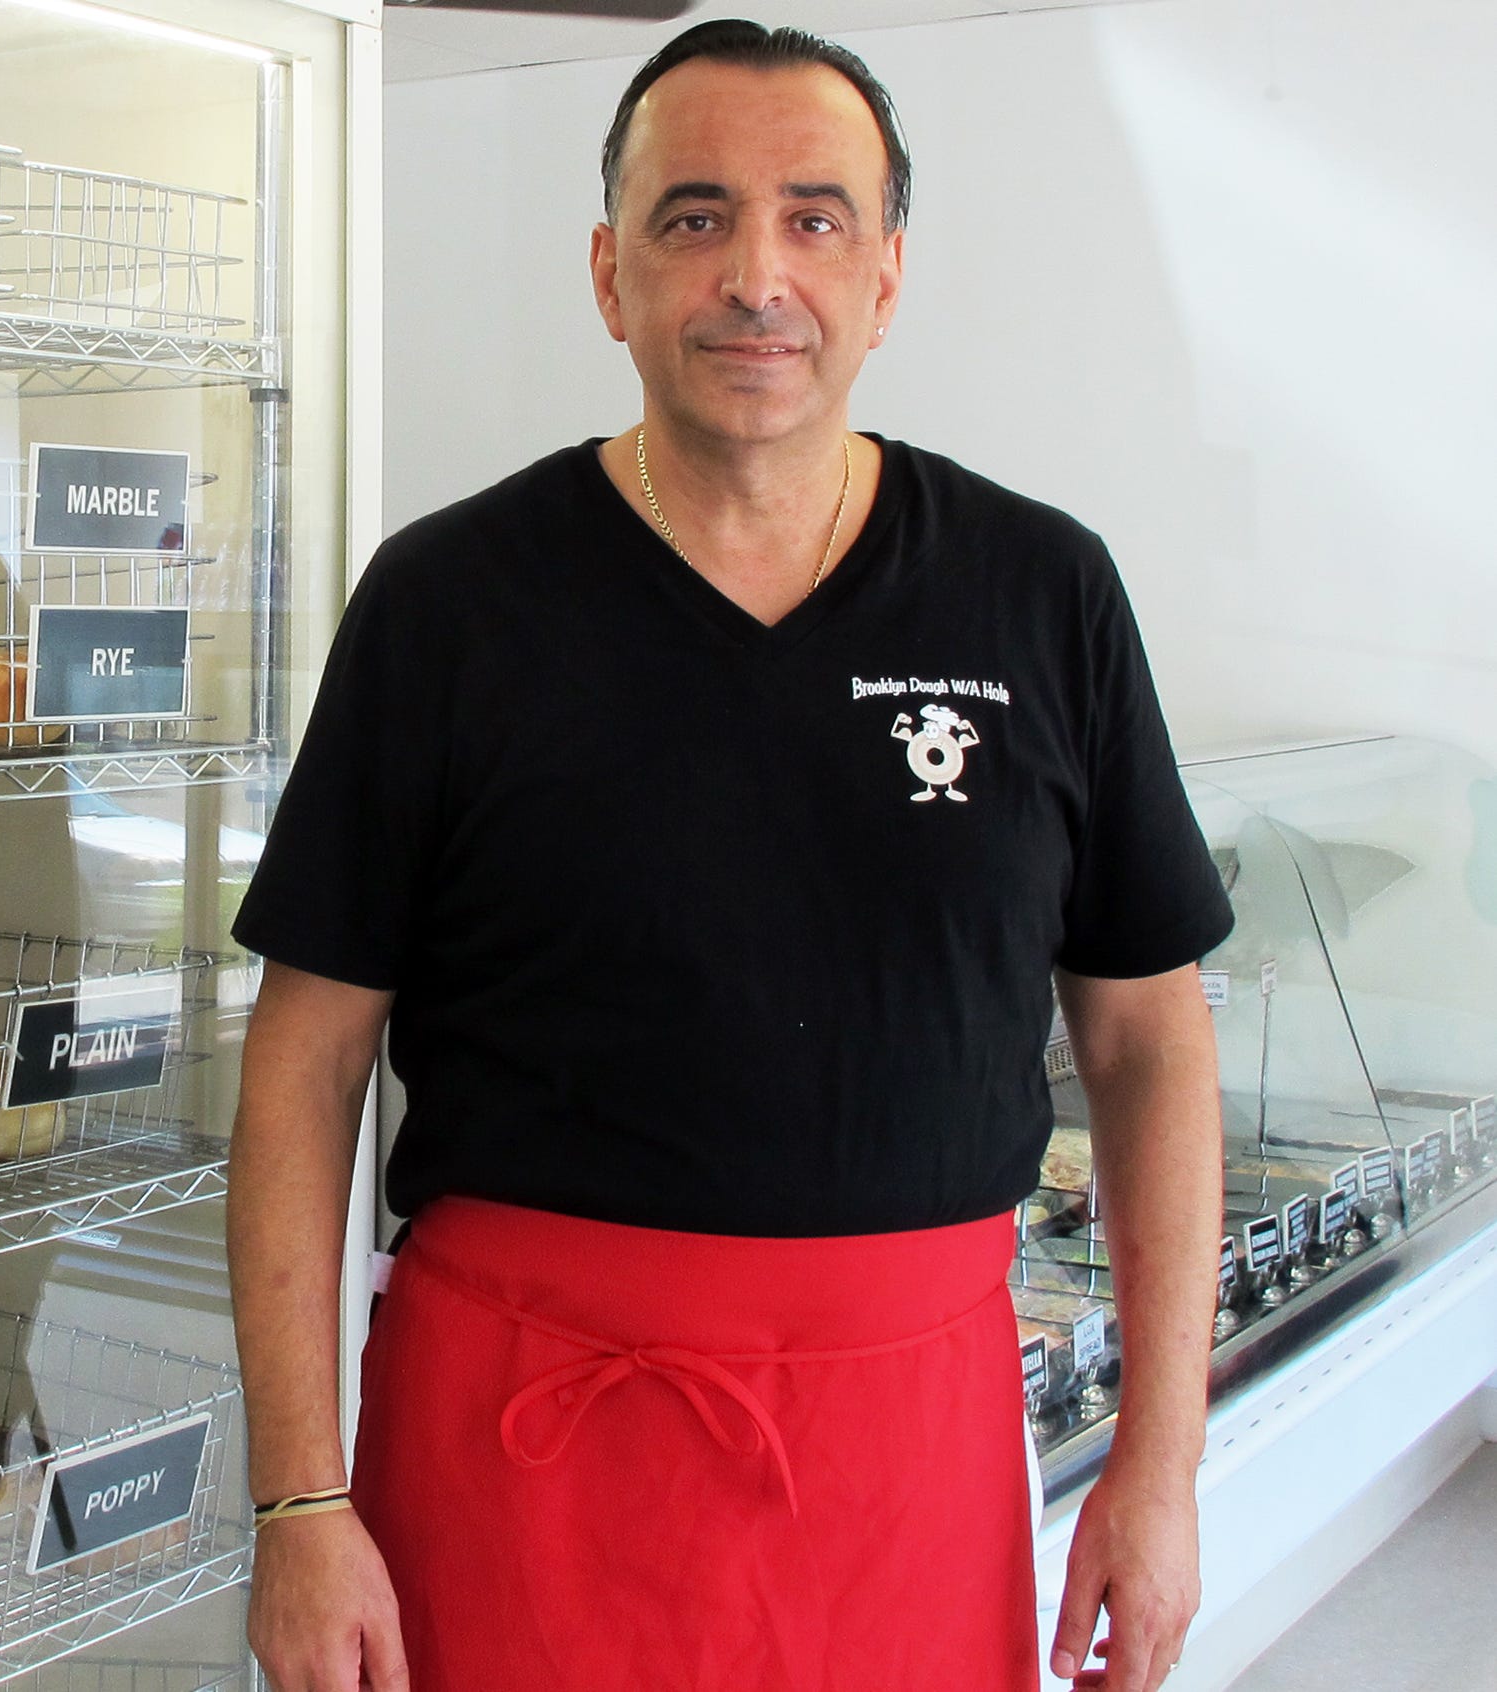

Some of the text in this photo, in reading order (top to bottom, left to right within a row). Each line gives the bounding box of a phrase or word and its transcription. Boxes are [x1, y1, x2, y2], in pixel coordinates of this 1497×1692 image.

[65, 484, 160, 518] MARBLE
[91, 647, 135, 676] RYE
[852, 676, 1010, 705] Brooklyn Dough W/A Hole
[48, 1024, 138, 1071] PLAIN
[84, 1466, 166, 1518] POPPY
